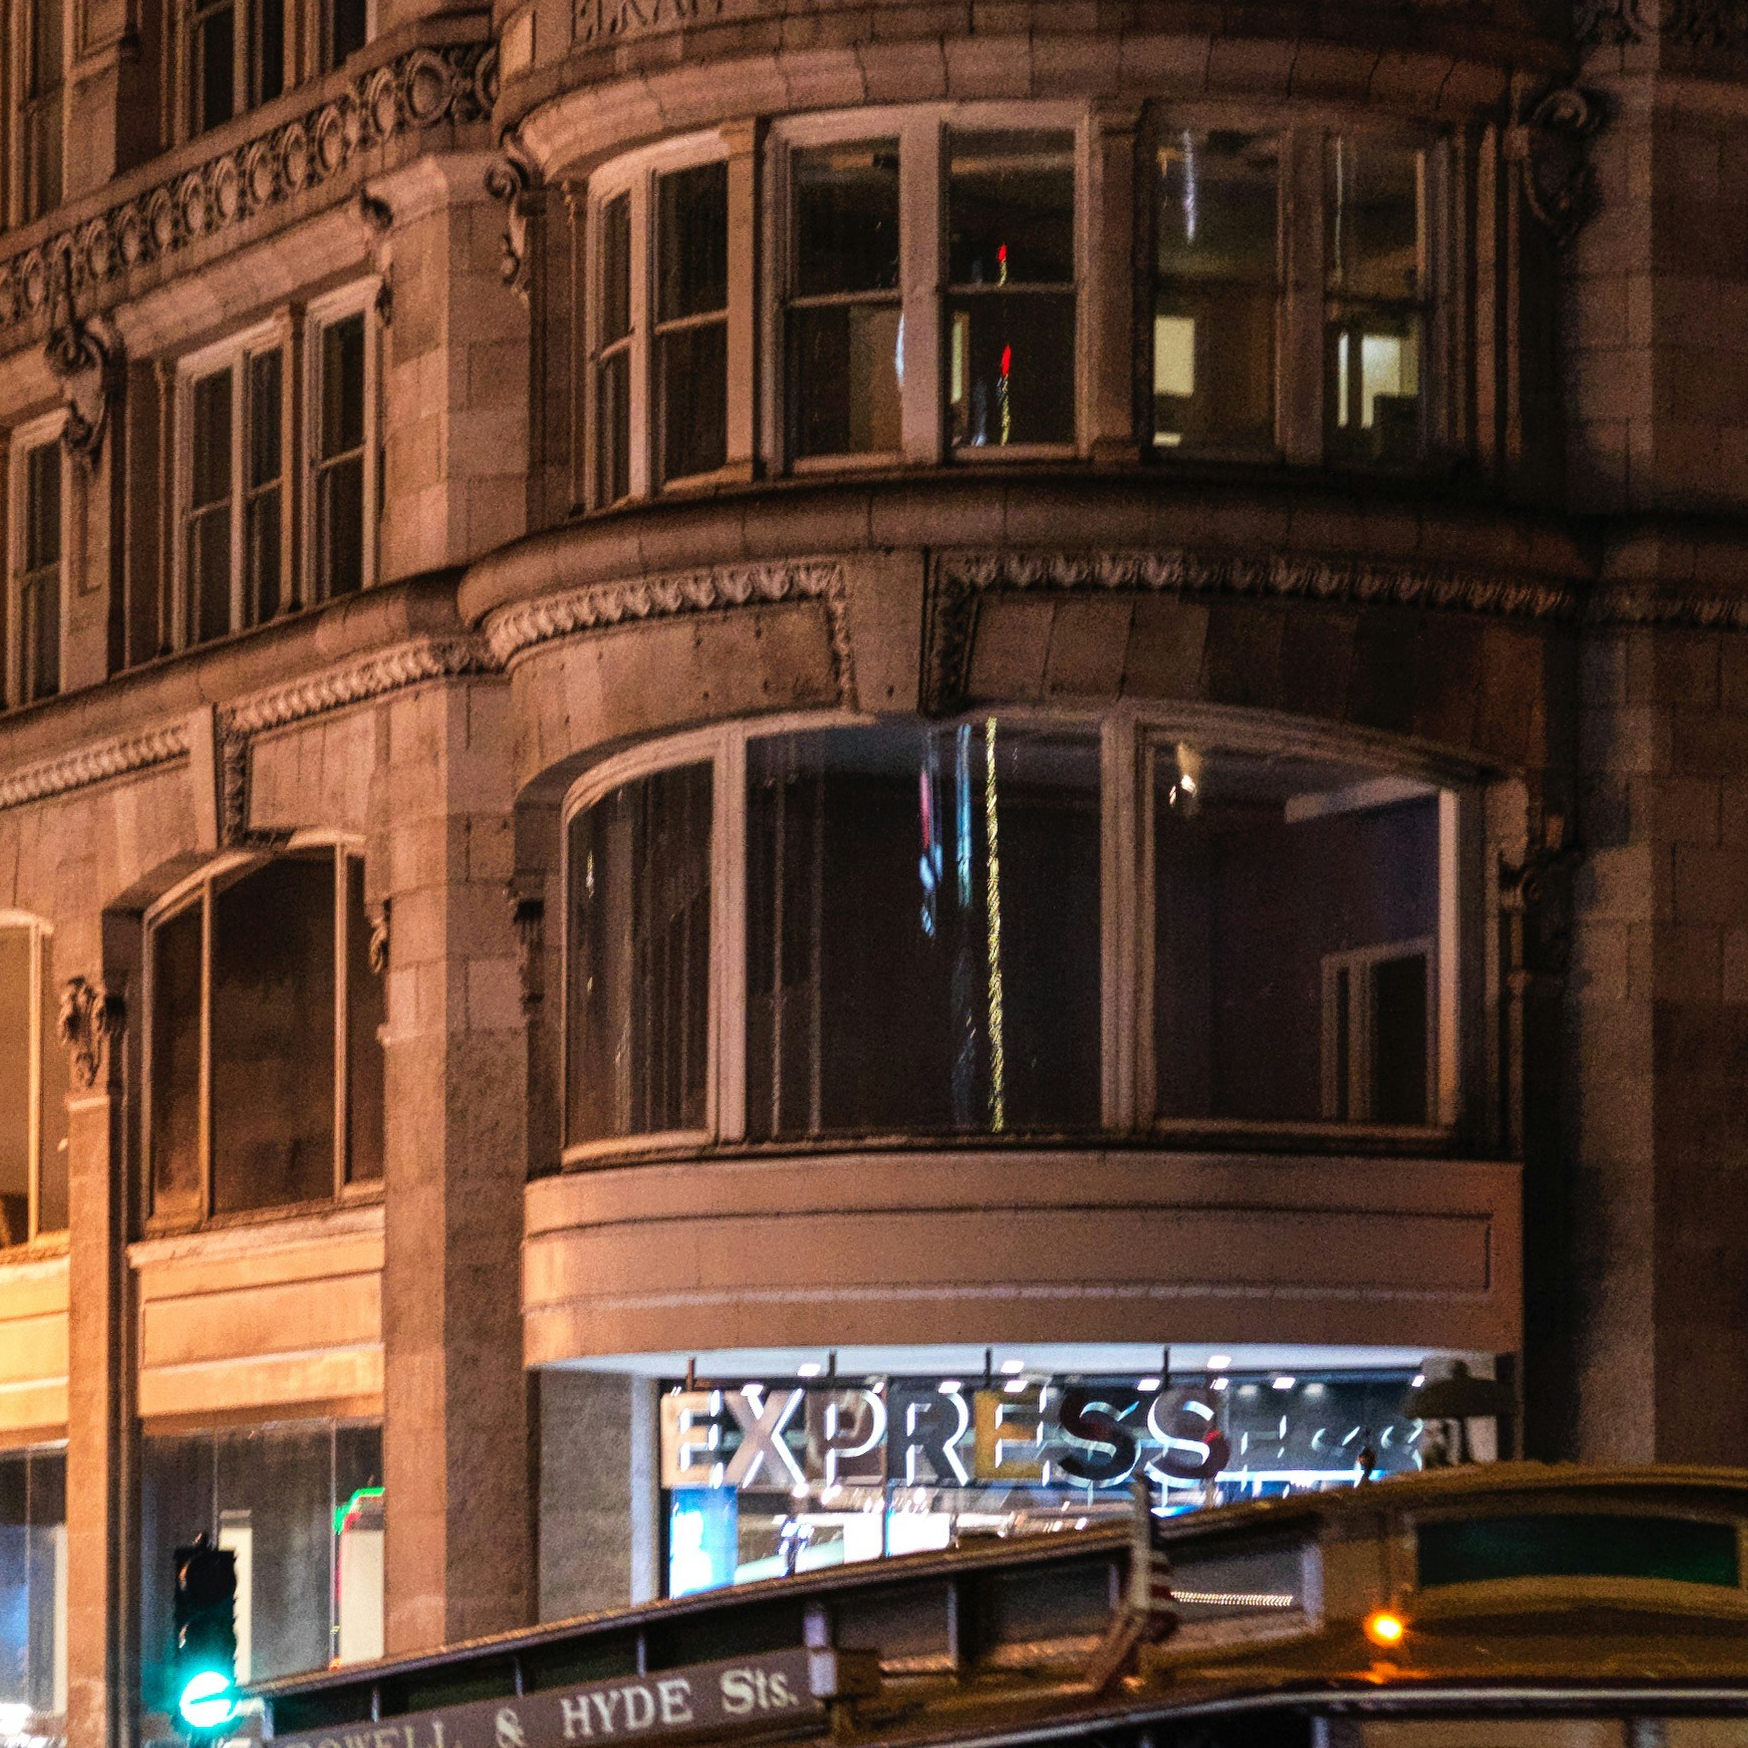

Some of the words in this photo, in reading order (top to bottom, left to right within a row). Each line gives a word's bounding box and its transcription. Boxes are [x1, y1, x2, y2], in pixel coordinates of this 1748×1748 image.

[659, 1389, 1231, 1488] EXPRESS
[562, 1677, 694, 1740] HYDE
[720, 1667, 799, 1715] Sts.
